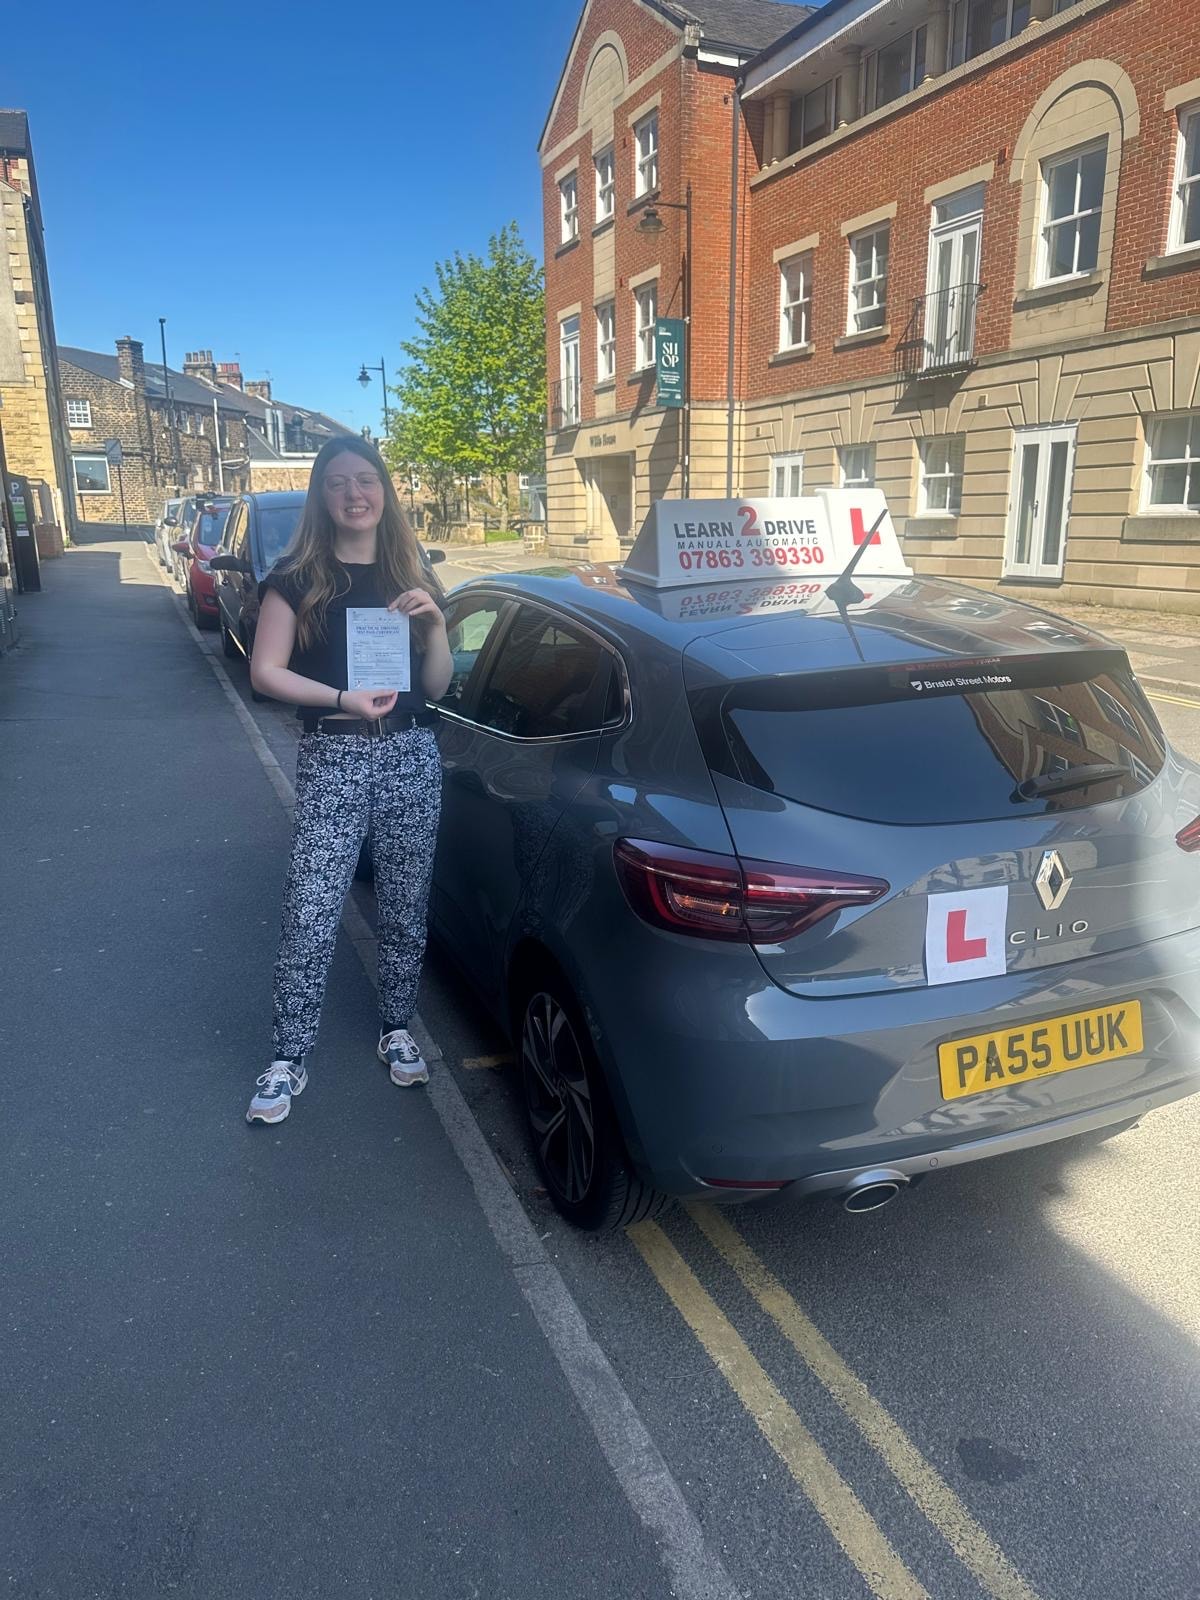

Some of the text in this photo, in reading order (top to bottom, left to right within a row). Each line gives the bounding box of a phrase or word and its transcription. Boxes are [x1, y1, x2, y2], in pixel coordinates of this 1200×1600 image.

[661, 354, 680, 368] OP
[11, 482, 19, 494] P
[673, 506, 816, 538] LEARN 2 DRIVE
[850, 508, 882, 545] L
[677, 537, 819, 550] MANUAL & AUTOMATIC
[679, 546, 825, 570] 07863 399330
[924, 675, 1012, 689] Bristol Street Motors
[946, 909, 987, 963] L
[1009, 920, 1089, 945] CLIO
[956, 1010, 1129, 1088] PA55 UUK
